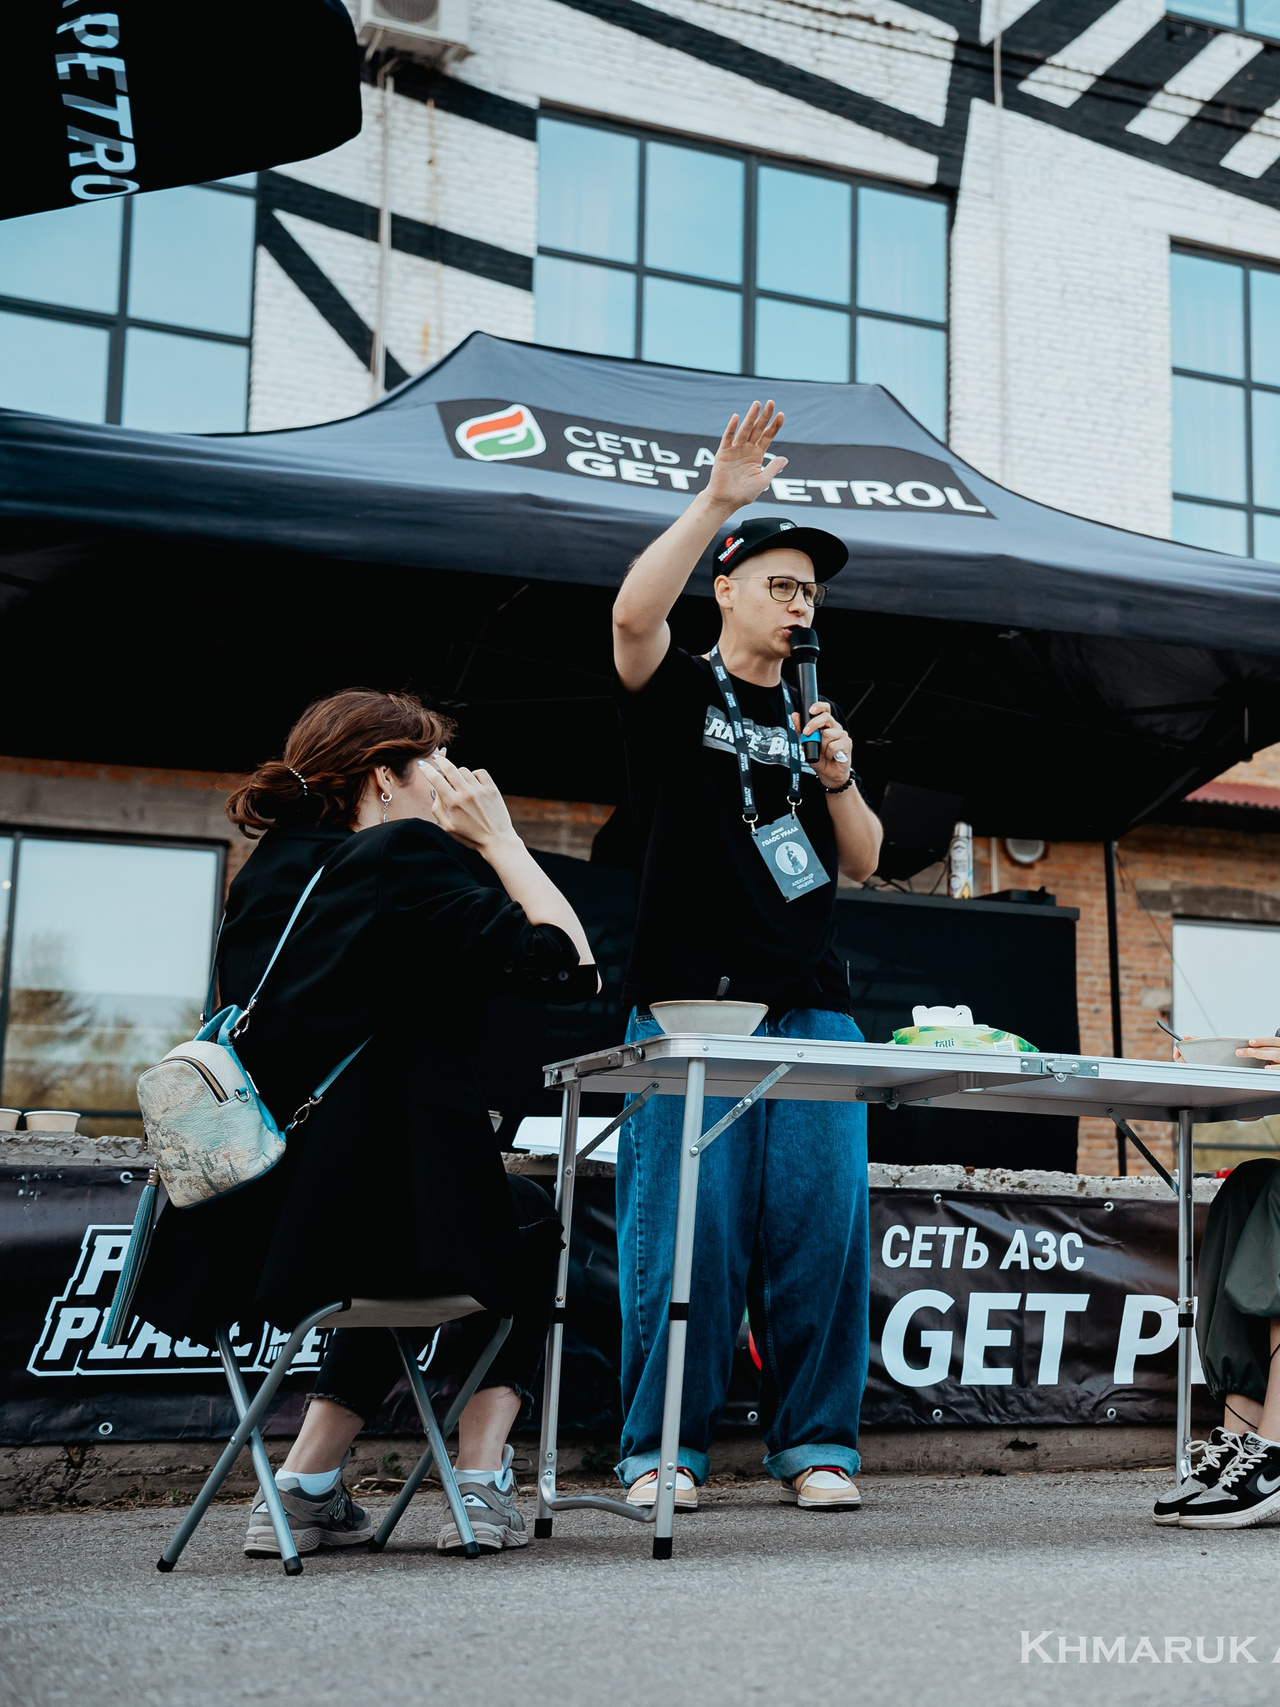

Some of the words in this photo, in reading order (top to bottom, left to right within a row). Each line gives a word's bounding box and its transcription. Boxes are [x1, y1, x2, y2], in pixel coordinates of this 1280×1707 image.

[563, 426, 680, 465] СЕТЬ
[693, 447, 783, 473] АС
[566, 450, 699, 490] GET
[763, 478, 987, 514] ETROL
[704, 717, 761, 751] RAE
[881, 1224, 990, 1269] СЕТЬ
[999, 1229, 1085, 1272] АЗС
[881, 1288, 1090, 1388] GET
